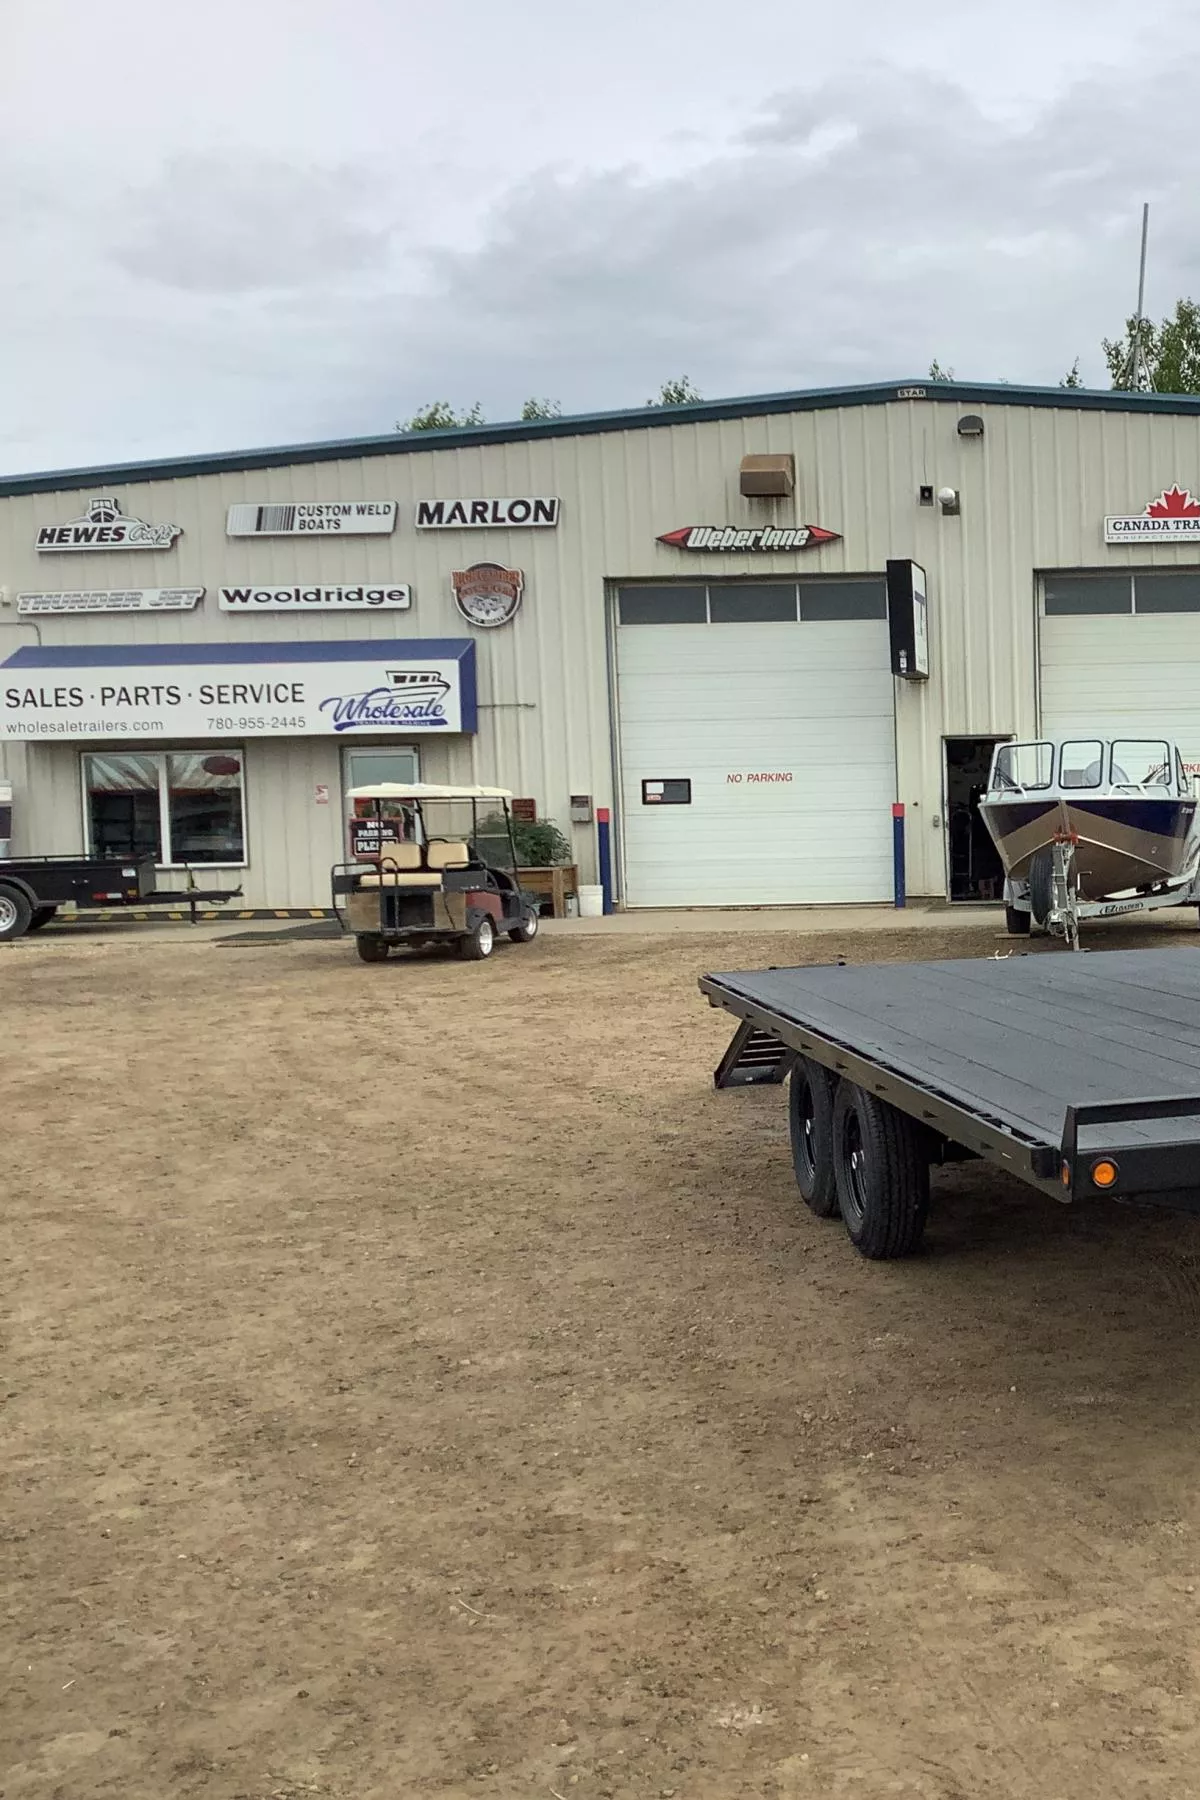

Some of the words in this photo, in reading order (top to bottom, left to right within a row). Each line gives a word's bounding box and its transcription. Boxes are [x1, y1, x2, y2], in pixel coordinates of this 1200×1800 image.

[297, 504, 351, 517] CUSTOM
[356, 504, 392, 516] WELD
[417, 499, 556, 525] MARLON
[298, 518, 341, 530] BOATS
[1112, 520, 1170, 531] CANADA
[37, 526, 126, 544] HEWES
[18, 591, 143, 611] THUNDER
[149, 589, 201, 607] JET
[222, 588, 406, 605] Wooldridge
[5, 687, 84, 708] SALES
[100, 685, 181, 706] PARTS
[199, 683, 306, 704] SERVICE
[319, 687, 446, 723] Wholesale
[6, 719, 164, 733] wholesaletrailers.com
[207, 716, 306, 731] 780-955-2445
[726, 774, 743, 783] NO
[747, 773, 793, 782] PARKING
